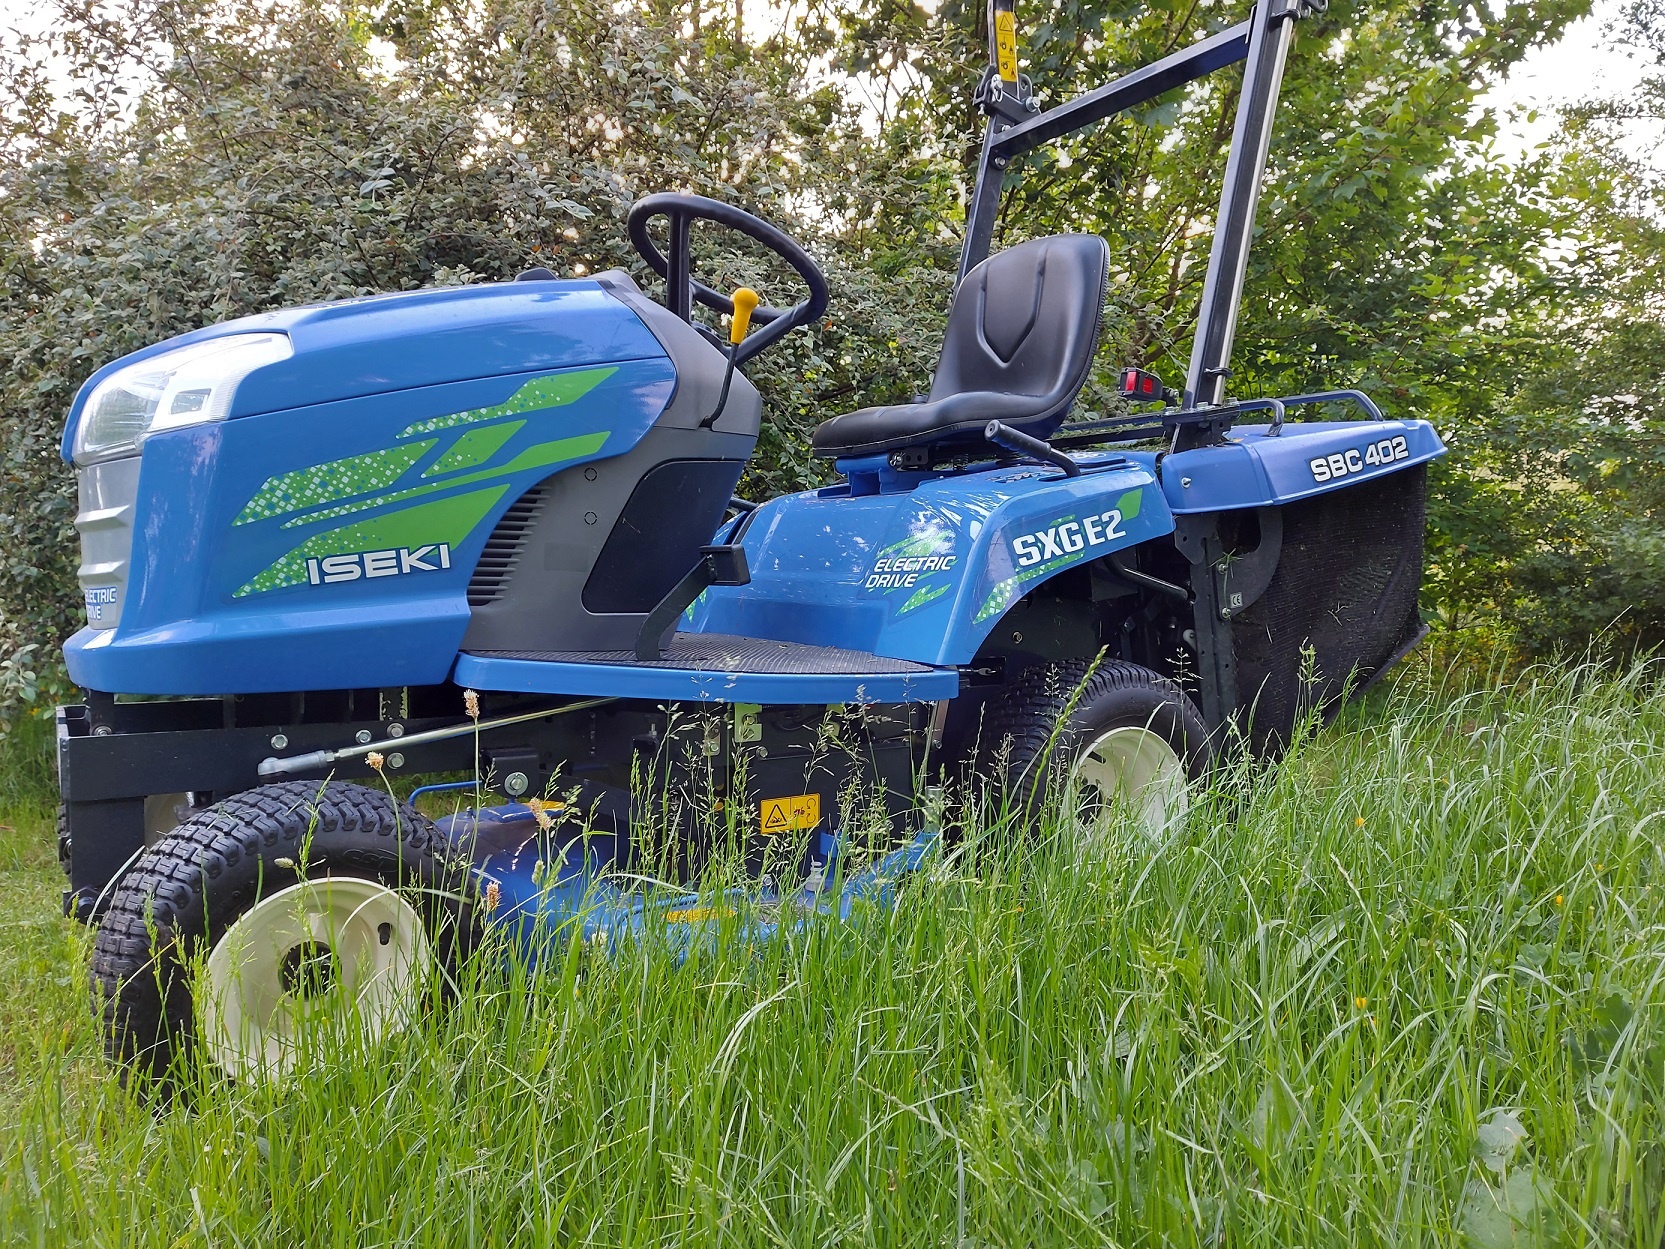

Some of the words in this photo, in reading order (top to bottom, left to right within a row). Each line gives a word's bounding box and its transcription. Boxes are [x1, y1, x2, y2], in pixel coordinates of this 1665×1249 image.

[1310, 448, 1364, 482] SBC
[1364, 435, 1409, 466] 402
[307, 543, 451, 585] ISEKI
[874, 555, 957, 573] ELECTRIC
[864, 573, 919, 588] DRIVE
